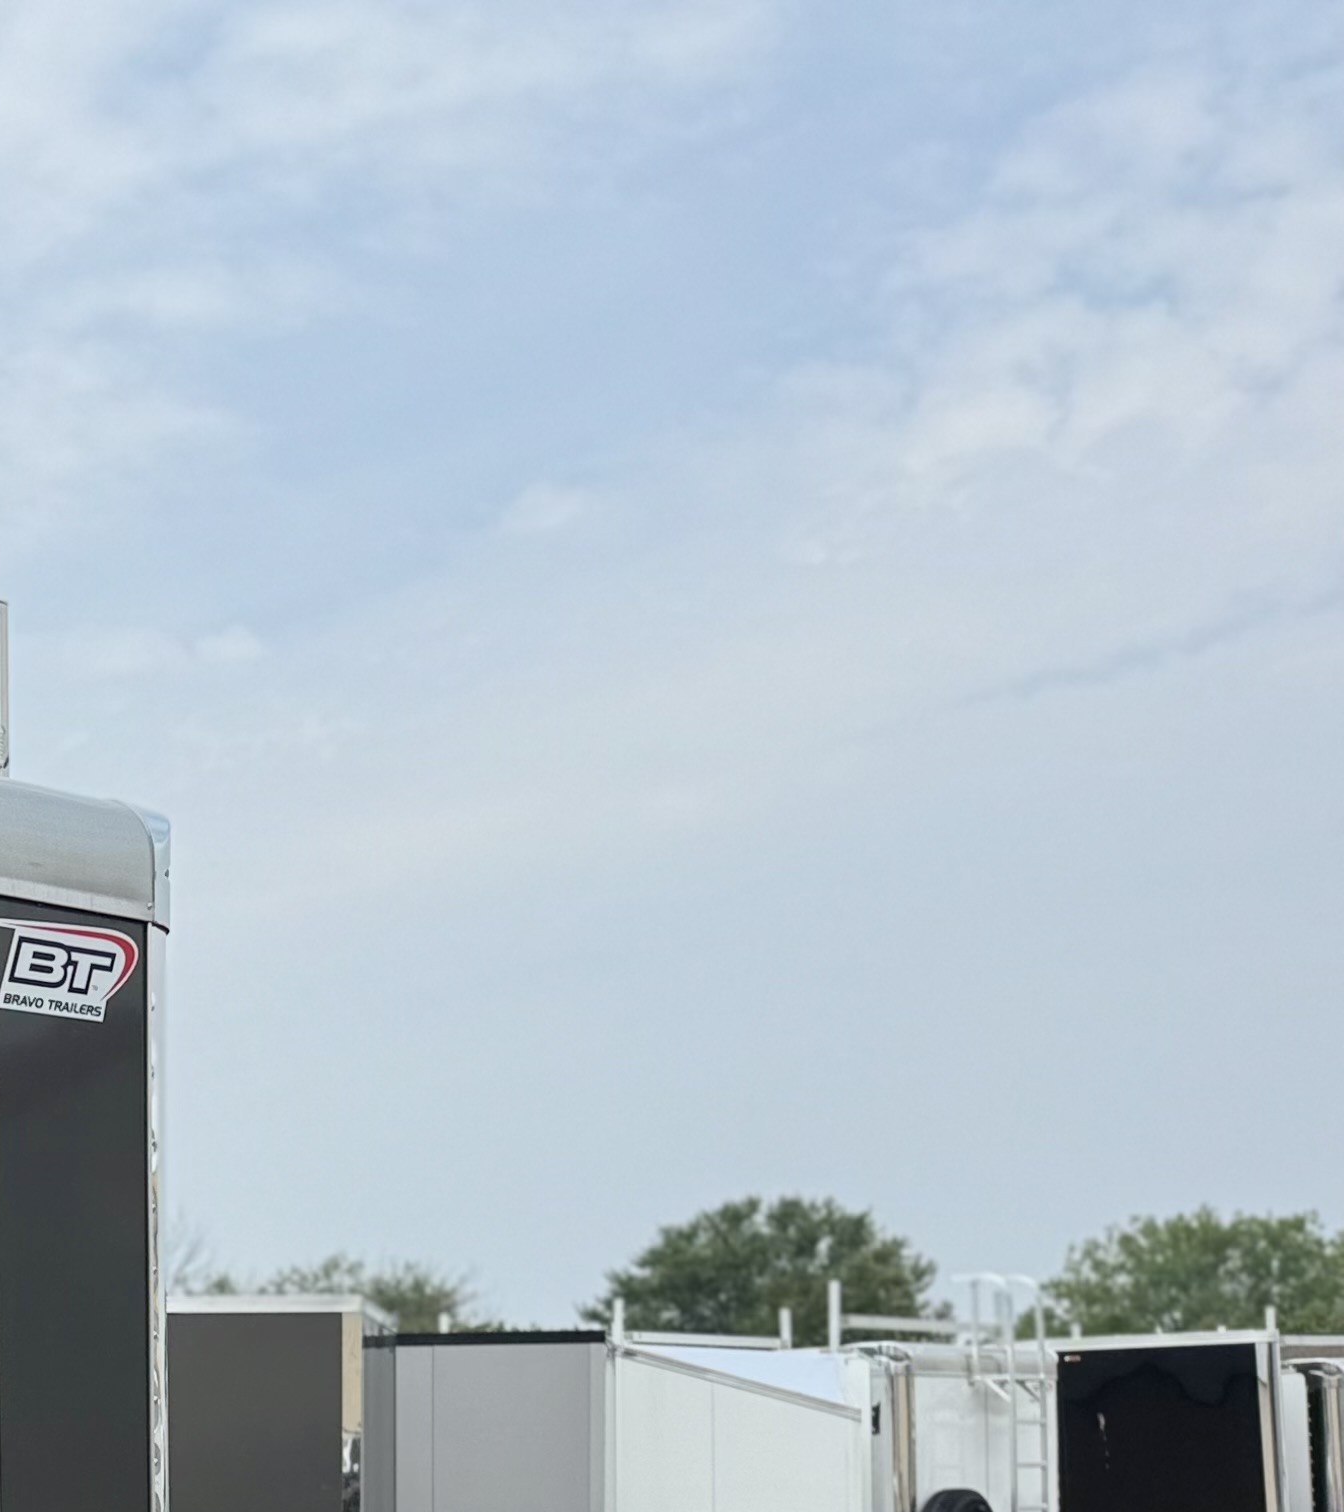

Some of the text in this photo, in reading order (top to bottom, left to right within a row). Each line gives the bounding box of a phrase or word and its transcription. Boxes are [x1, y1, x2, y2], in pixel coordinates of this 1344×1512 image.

[8, 935, 116, 995] BT
[2, 992, 103, 1017] BRAVO TRAILERS
